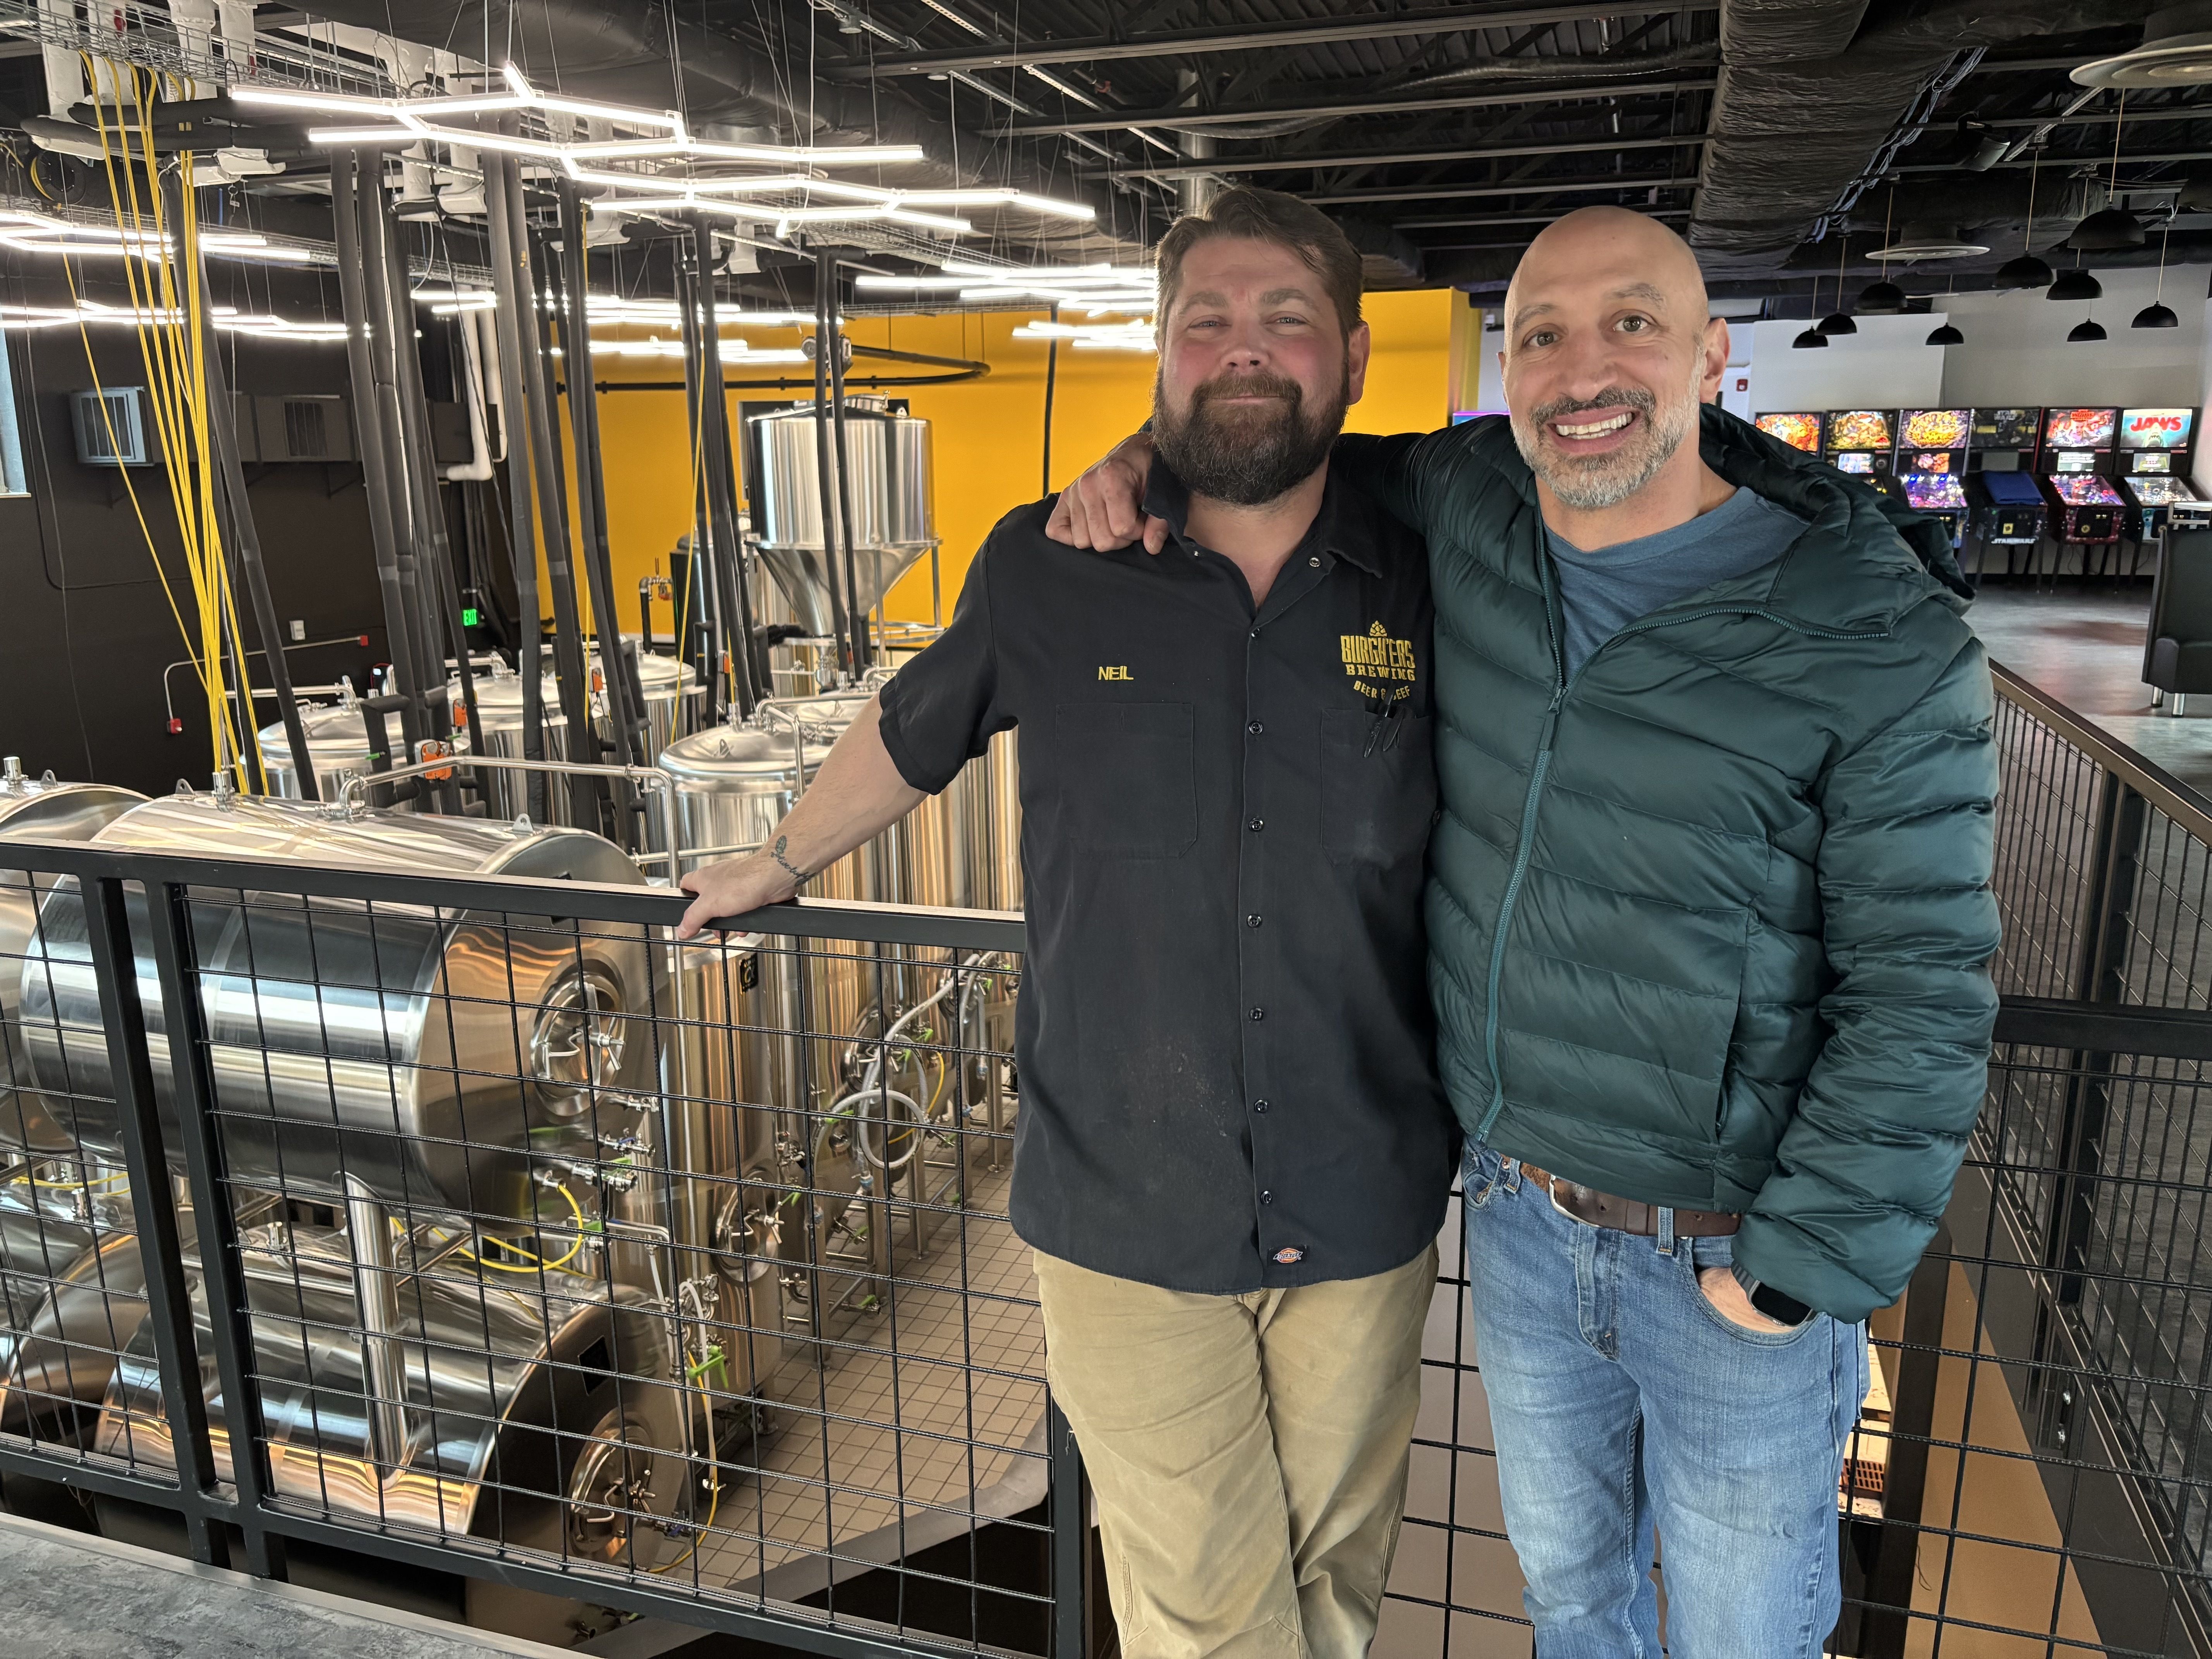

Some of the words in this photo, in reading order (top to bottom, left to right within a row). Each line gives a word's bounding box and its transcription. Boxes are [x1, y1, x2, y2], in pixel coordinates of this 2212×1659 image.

[2131, 417, 2182, 431] JAWS
[463, 609, 477, 626] EXIT
[1340, 635, 1416, 668] BURGH'ERS
[1098, 665, 1134, 680] NEIL
[1345, 664, 1416, 681] BREWING
[1353, 680, 1377, 698] BEER
